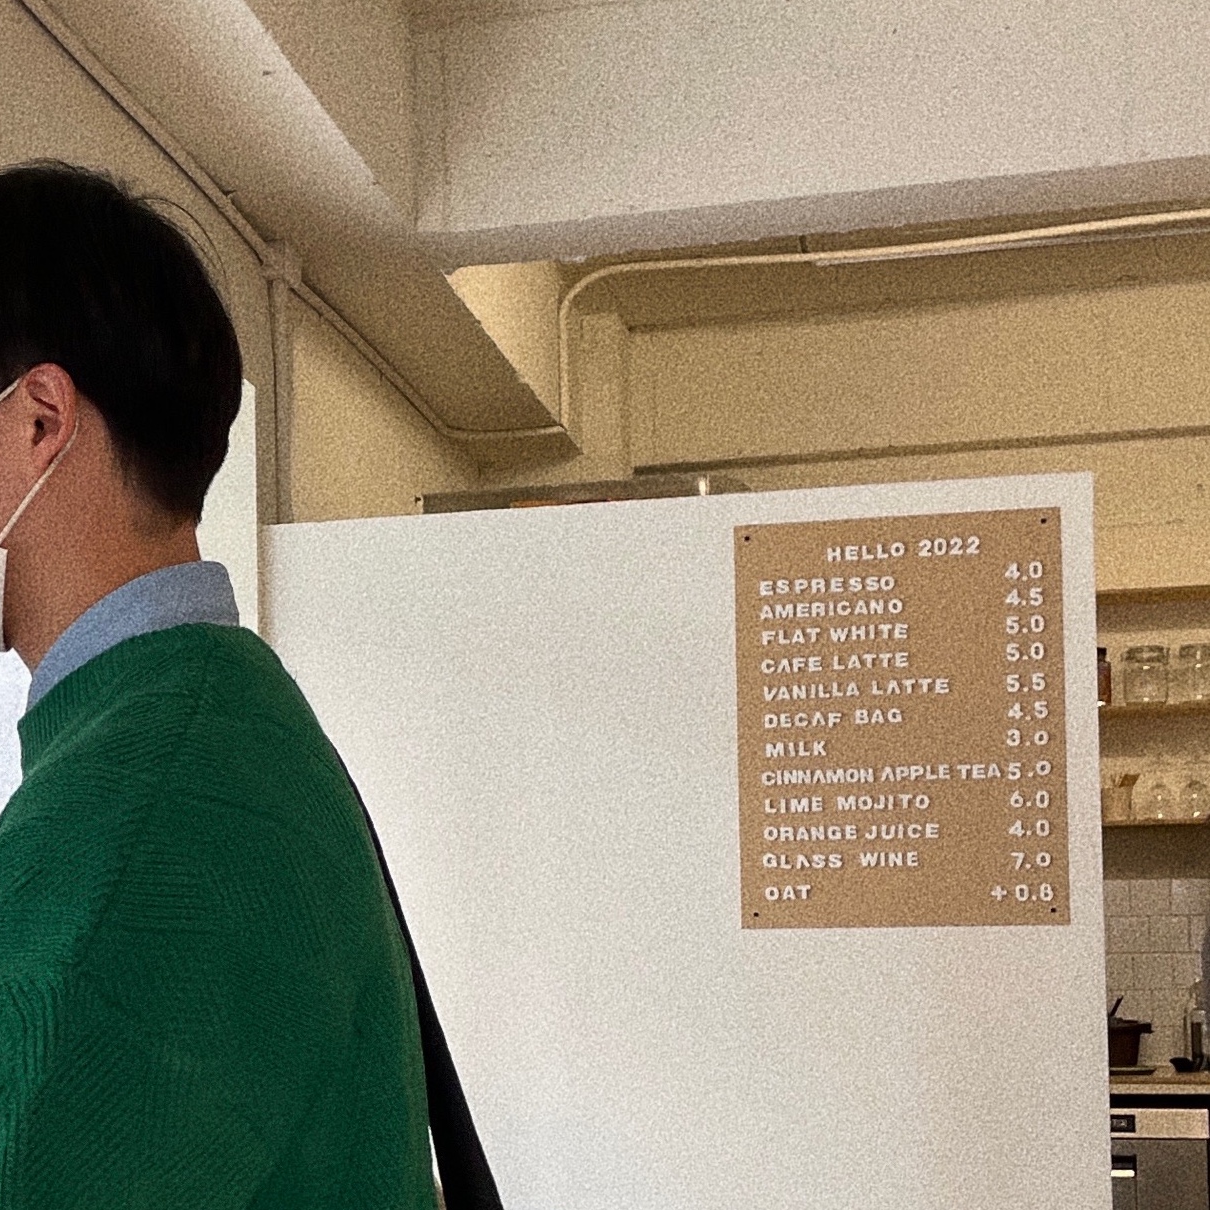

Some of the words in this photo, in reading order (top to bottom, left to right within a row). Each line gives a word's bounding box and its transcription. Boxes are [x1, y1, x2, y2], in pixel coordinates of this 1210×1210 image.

[827, 542, 906, 562] HELLO
[918, 536, 981, 557] 2022
[759, 576, 895, 596] ESPRESSO
[1004, 561, 1043, 581] 4.0
[759, 599, 903, 620] AMERICANO
[1004, 588, 1044, 606] 4.5
[761, 628, 821, 646] FLAT
[830, 623, 909, 643] WHITE
[1006, 614, 1044, 634] 5.0
[760, 656, 823, 675] CAFE
[833, 652, 909, 671] LATTE
[1006, 642, 1044, 661] 5.0
[762, 680, 860, 701] VANILLA
[871, 678, 950, 695] LATTE
[1006, 673, 1046, 693] 5.5
[764, 712, 841, 729] DECAF
[855, 708, 903, 725] BAG
[1007, 702, 1049, 720] 4.5
[765, 740, 827, 758] MILK
[1007, 729, 1050, 746] 3.0
[761, 767, 874, 786] CINNAMON
[881, 764, 950, 781] APPLE
[957, 763, 1001, 780] TEA
[1008, 760, 1051, 780] 5.0
[765, 797, 823, 814] LIME
[837, 794, 930, 811] MOJITO
[1009, 790, 1050, 808] 6.0
[763, 825, 857, 842] ORANGE
[865, 823, 940, 840] JUICE
[1009, 819, 1050, 837] 4.0
[762, 853, 843, 869] GLASS
[859, 851, 919, 867] WINE
[1010, 851, 1051, 870] 7.0
[765, 884, 811, 901] OAT
